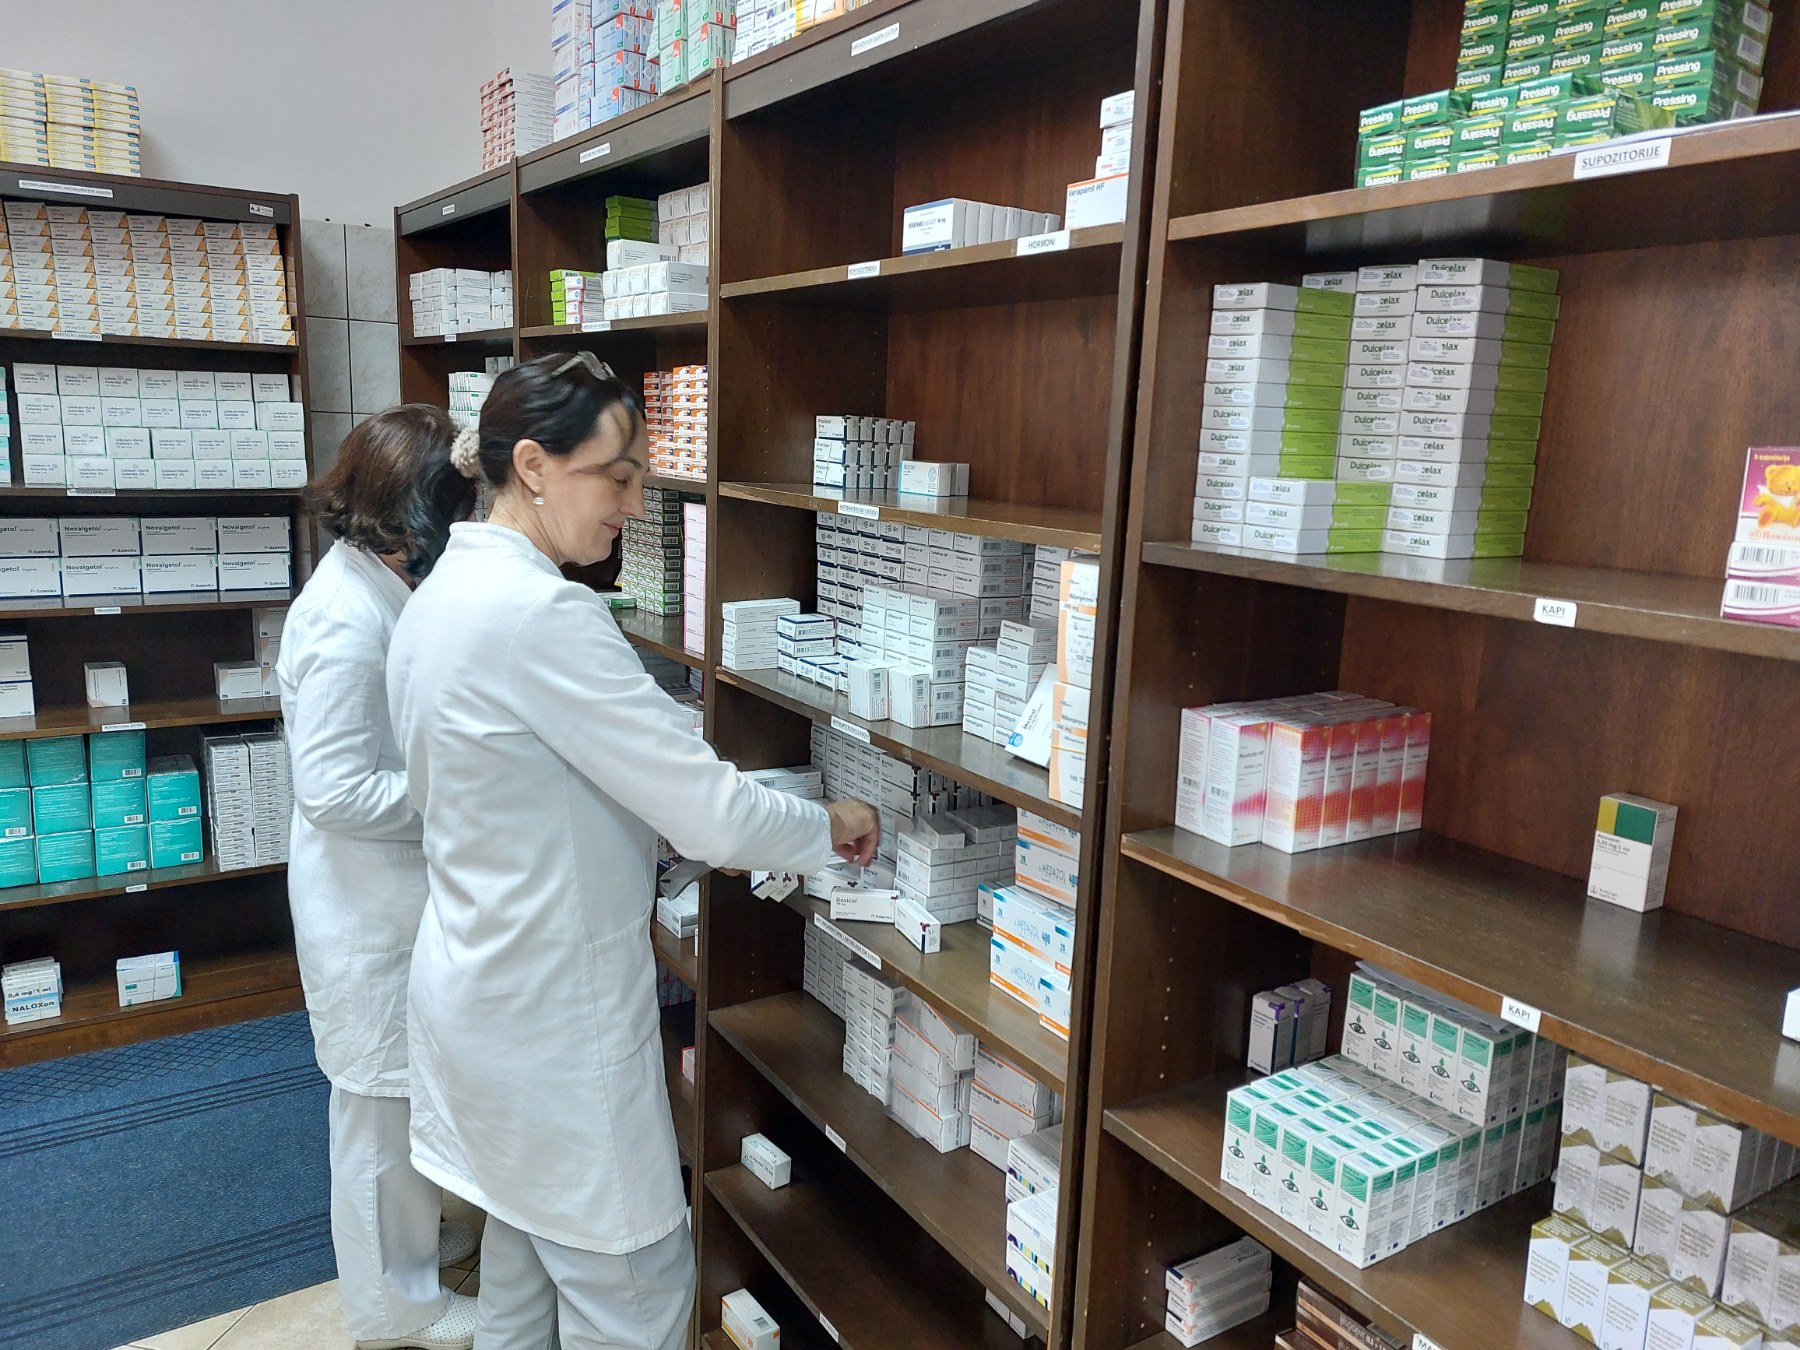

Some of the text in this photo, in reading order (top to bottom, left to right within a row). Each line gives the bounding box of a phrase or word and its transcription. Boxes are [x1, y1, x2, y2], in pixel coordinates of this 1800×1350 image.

[1511, 3, 1549, 18] Pressing
[1606, 8, 1648, 26] Pressing
[1463, 14, 1498, 29] Pressing
[1554, 20, 1593, 37] Pressing
[1508, 34, 1545, 48] Pressing
[1656, 28, 1699, 44] Pressing
[1460, 44, 1494, 57] Pressing
[1602, 42, 1643, 57] Pressing
[1552, 54, 1590, 69] Pressing
[1656, 61, 1700, 76] Pressing
[1504, 64, 1541, 79] Pressing
[1602, 72, 1643, 86] Pressing
[1456, 73, 1491, 86] Pressing
[1520, 84, 1560, 100] Pressing
[1472, 96, 1509, 110] Pressing
[1653, 93, 1697, 108] Pressing
[1404, 101, 1438, 117] Pressing
[1566, 107, 1611, 122] Pressing
[1361, 112, 1394, 128] Pressing
[1512, 118, 1554, 132] Pressing
[1460, 128, 1500, 141] Pressing
[1414, 137, 1450, 150] Pressing
[1368, 146, 1403, 158] Pressing
[1582, 146, 1661, 168] SUPOZITORIJE
[1068, 183, 1105, 197] Verapamil HF
[1028, 239, 1056, 250] HORMONI
[1206, 479, 1234, 487] Dulcelax
[146, 524, 181, 532] Novalgetol
[1542, 604, 1565, 617] KAPI
[12, 1002, 54, 1012] NALOXon
[1508, 1005, 1530, 1020] KAPI
